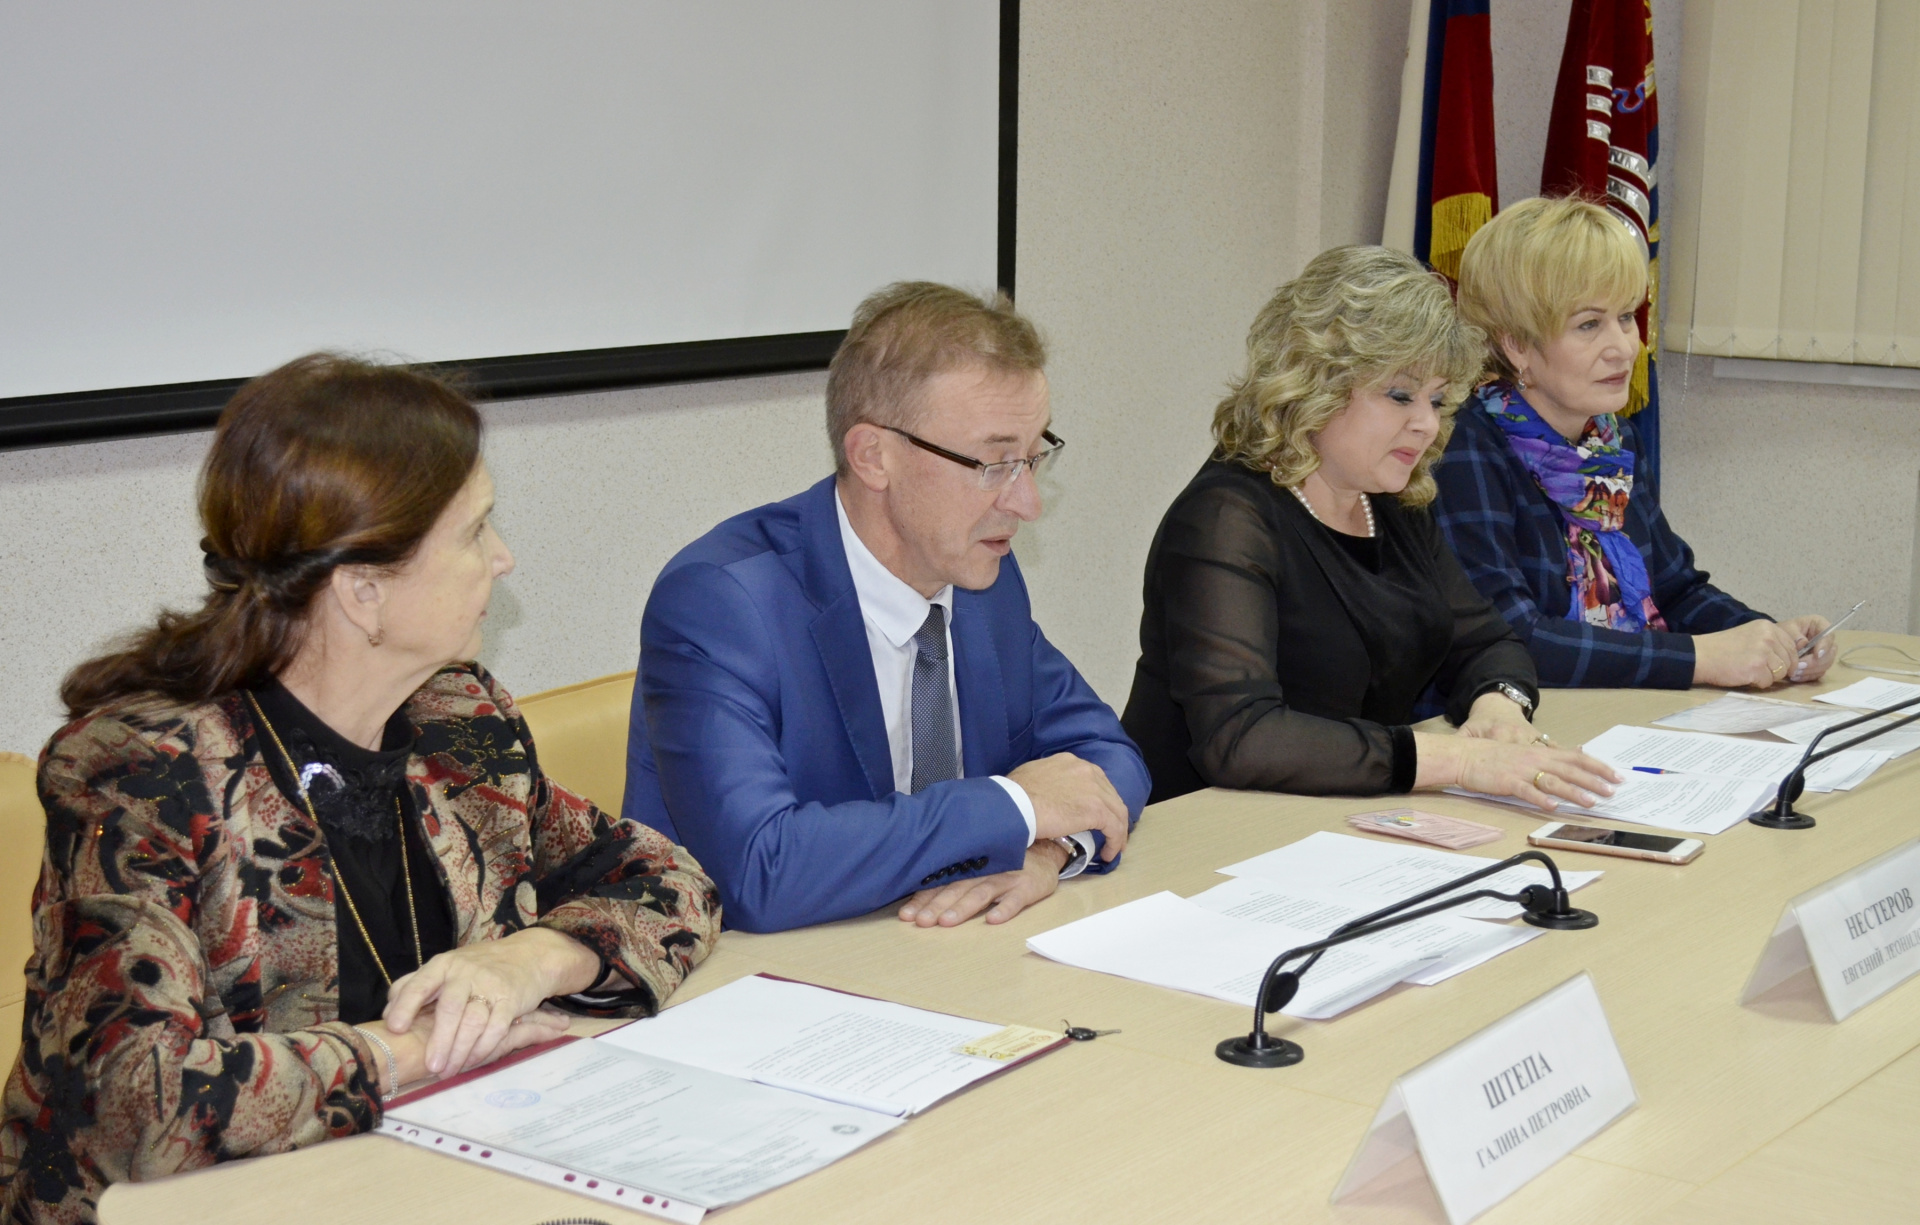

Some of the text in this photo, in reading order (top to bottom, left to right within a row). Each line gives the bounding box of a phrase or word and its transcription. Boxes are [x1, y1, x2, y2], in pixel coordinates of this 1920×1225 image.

[1844, 887, 1914, 940] НЕСТЕРОВ
[1841, 946, 1885, 985] ЕВГЕНИЙ
[1482, 1051, 1553, 1109] ШТЕПА
[1475, 1084, 1592, 1169] ГАЛИНА ПЕТРОВНА
